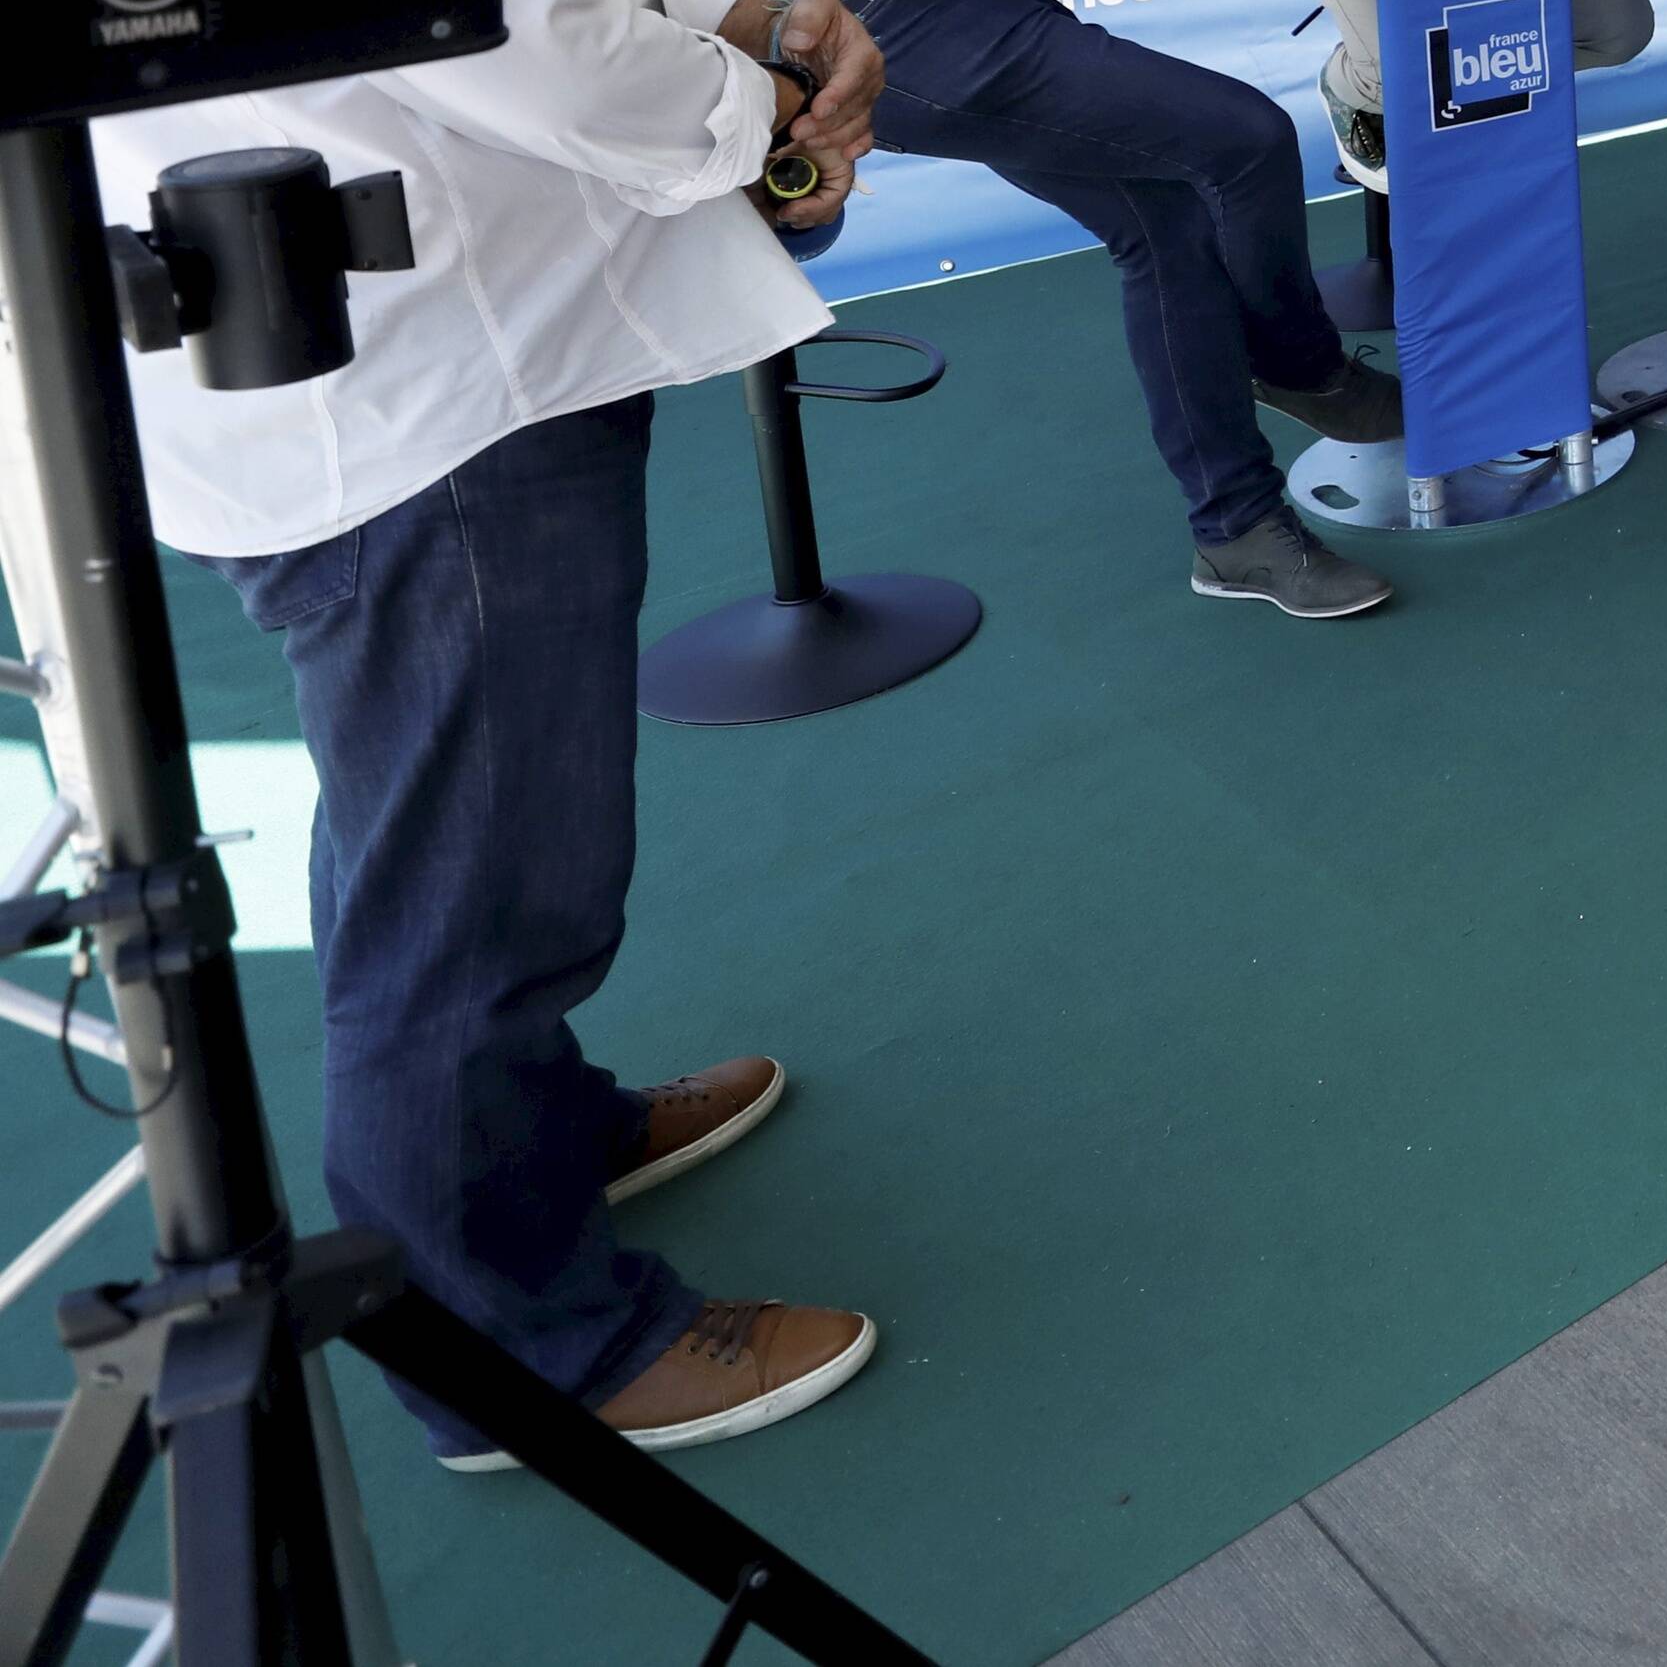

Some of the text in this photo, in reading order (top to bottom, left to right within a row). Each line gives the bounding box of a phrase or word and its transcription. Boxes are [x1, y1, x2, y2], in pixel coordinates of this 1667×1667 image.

[99, 9, 201, 47] YAMAHA
[1489, 28, 1539, 49] france
[1453, 42, 1543, 88] bleu
[1510, 73, 1543, 91] azur
